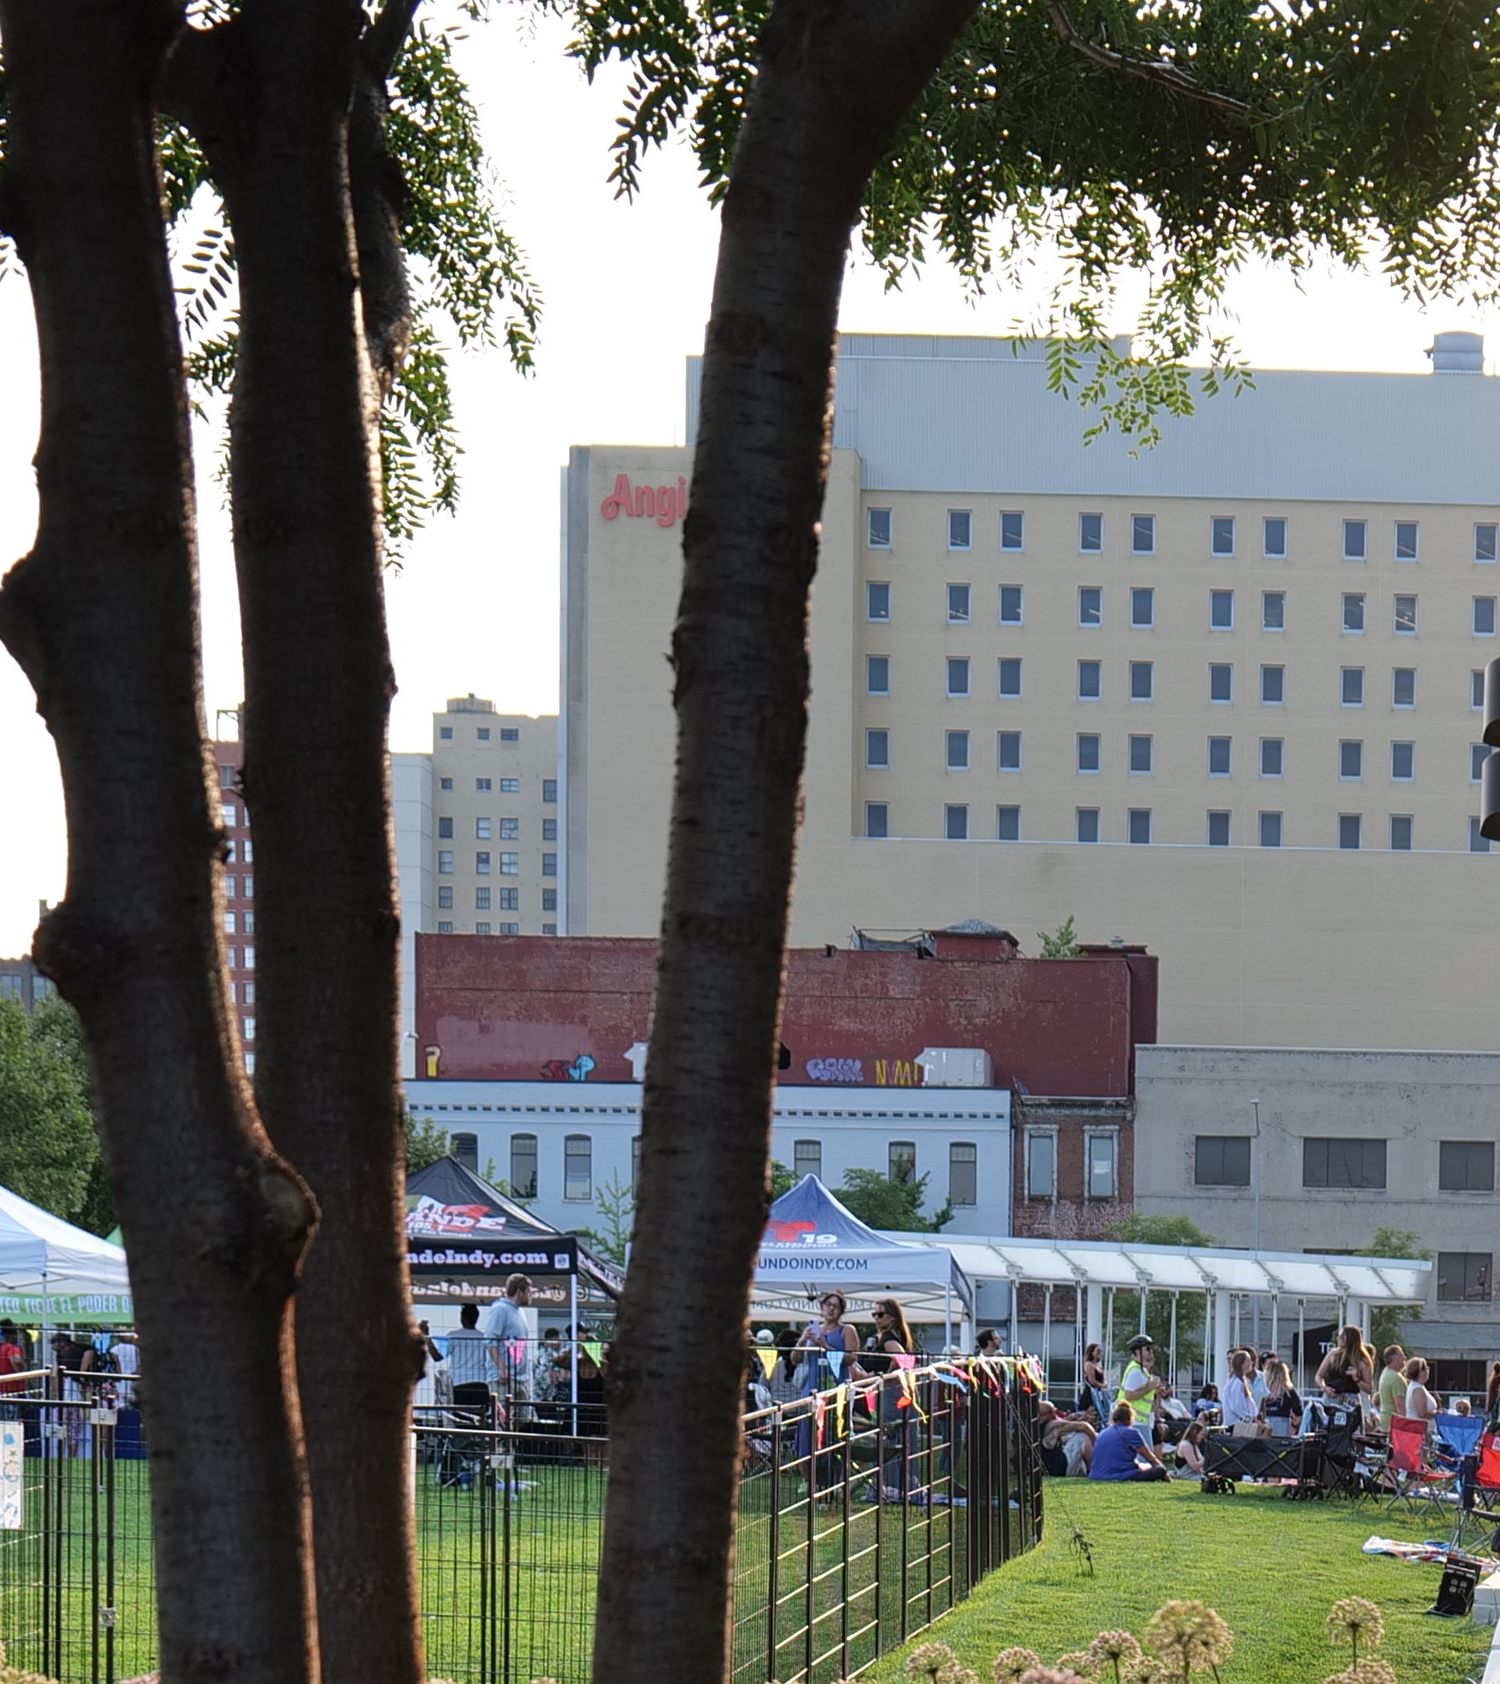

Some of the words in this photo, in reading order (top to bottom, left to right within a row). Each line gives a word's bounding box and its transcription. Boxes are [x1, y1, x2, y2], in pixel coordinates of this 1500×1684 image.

[601, 473, 687, 527] Angi
[405, 1249, 549, 1268] ndeIndy.com
[757, 1257, 869, 1271] UNDOINDY.COM
[78, 1294, 118, 1313] PODER
